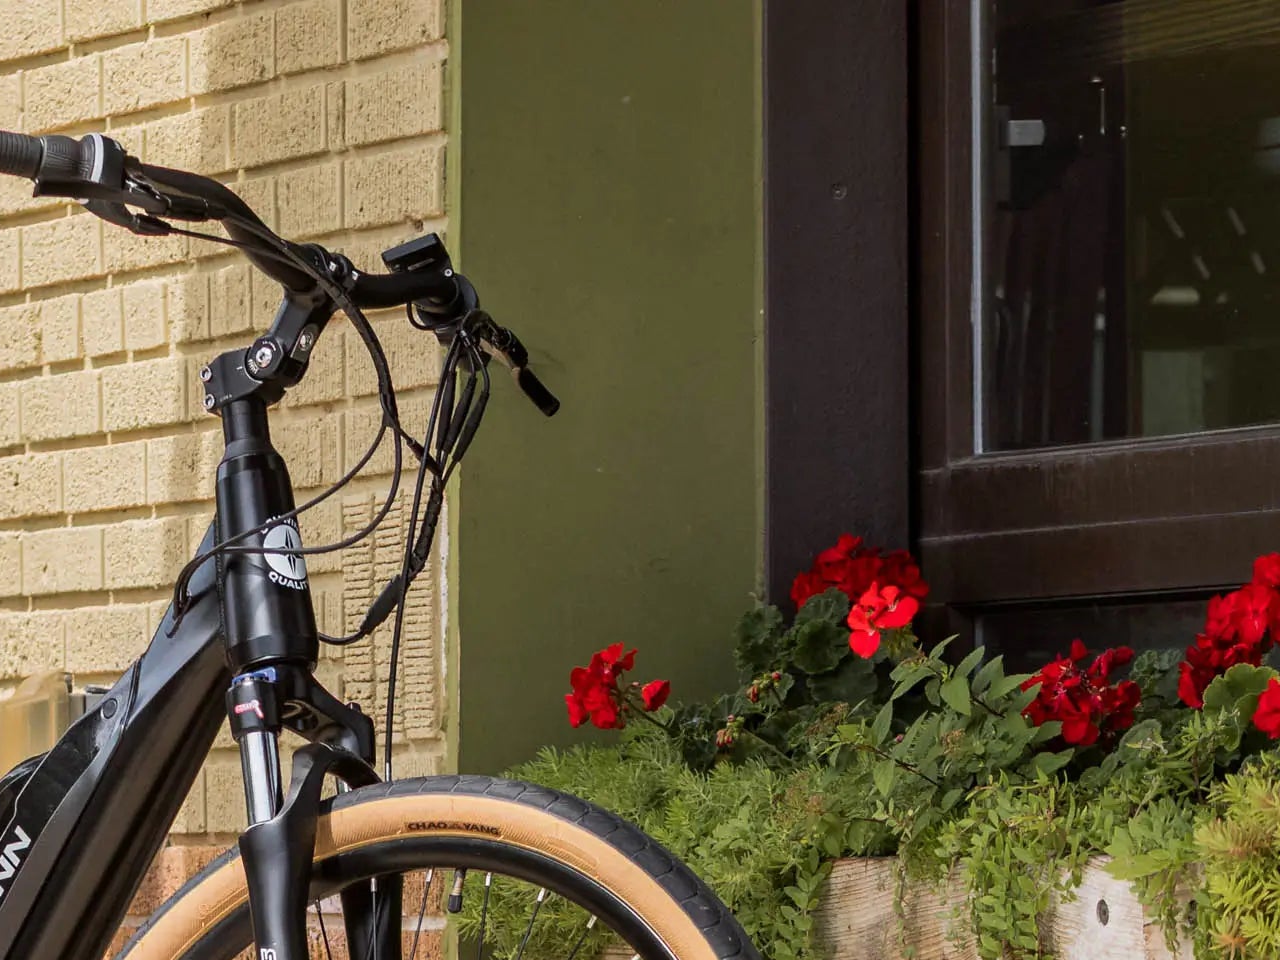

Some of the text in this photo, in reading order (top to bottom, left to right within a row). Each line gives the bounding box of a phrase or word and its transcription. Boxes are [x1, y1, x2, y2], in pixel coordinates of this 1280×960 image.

[268, 571, 308, 590] QUALIT
[407, 822, 500, 836] CHAO YANG
